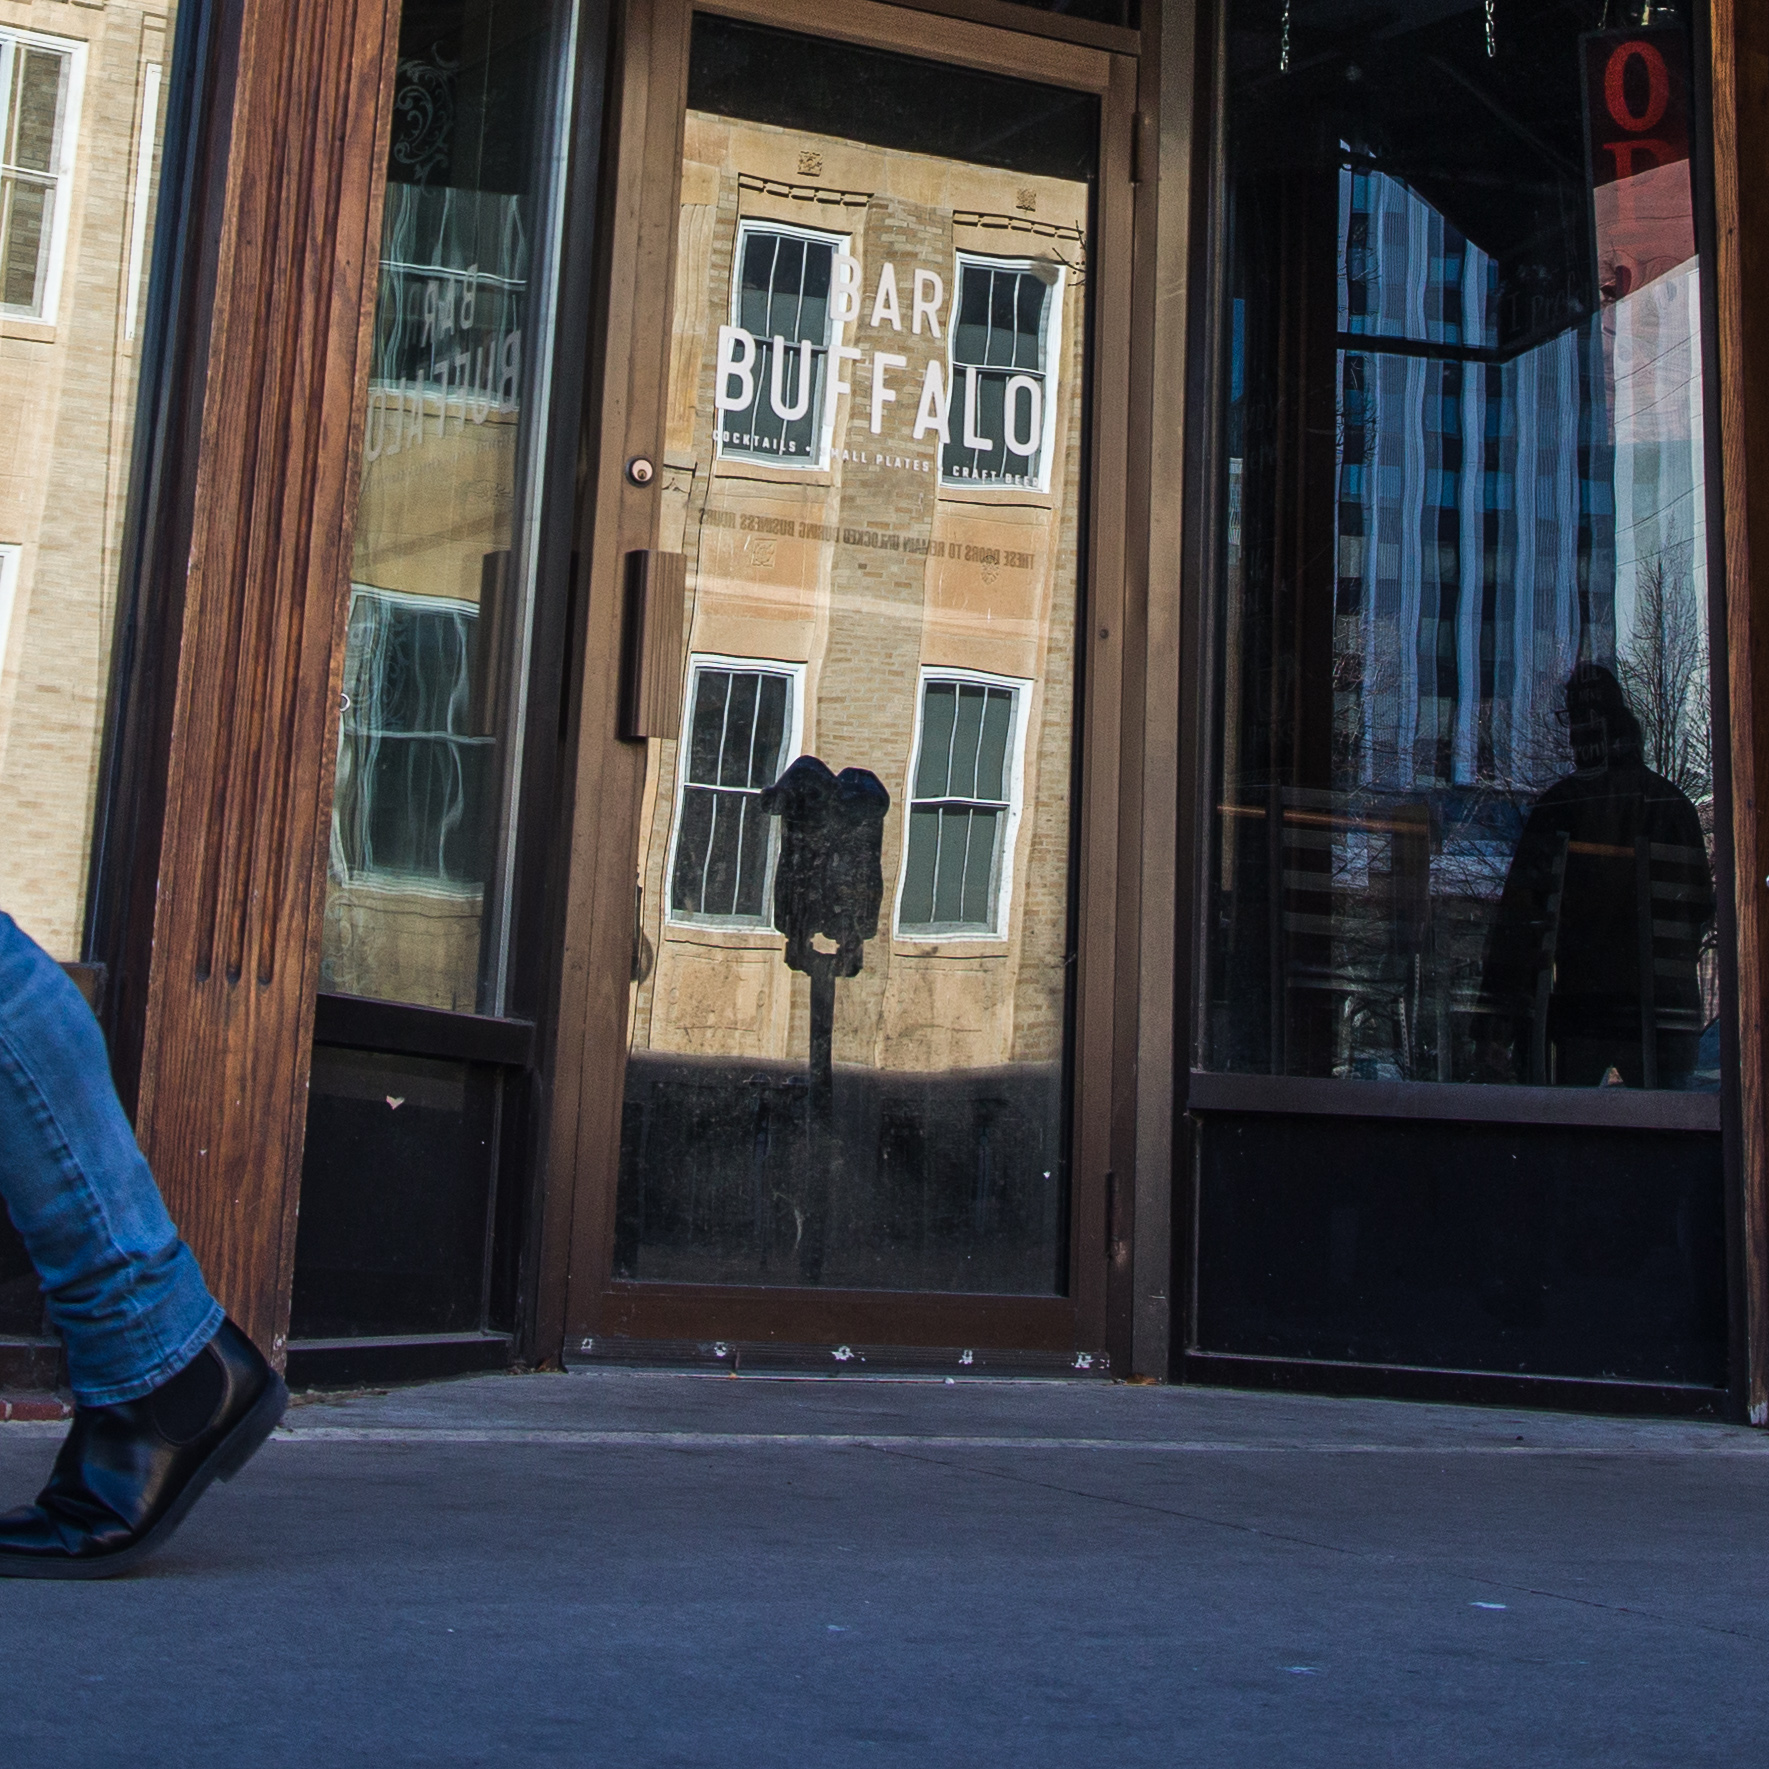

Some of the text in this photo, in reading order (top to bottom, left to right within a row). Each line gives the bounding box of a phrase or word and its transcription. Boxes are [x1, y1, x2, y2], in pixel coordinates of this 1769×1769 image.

[829, 252, 944, 339] BAR
[715, 325, 1041, 457] BUFFALO
[712, 429, 797, 453] COCKTAILS
[875, 454, 930, 473] PLATES
[952, 465, 997, 485] CRAFT
